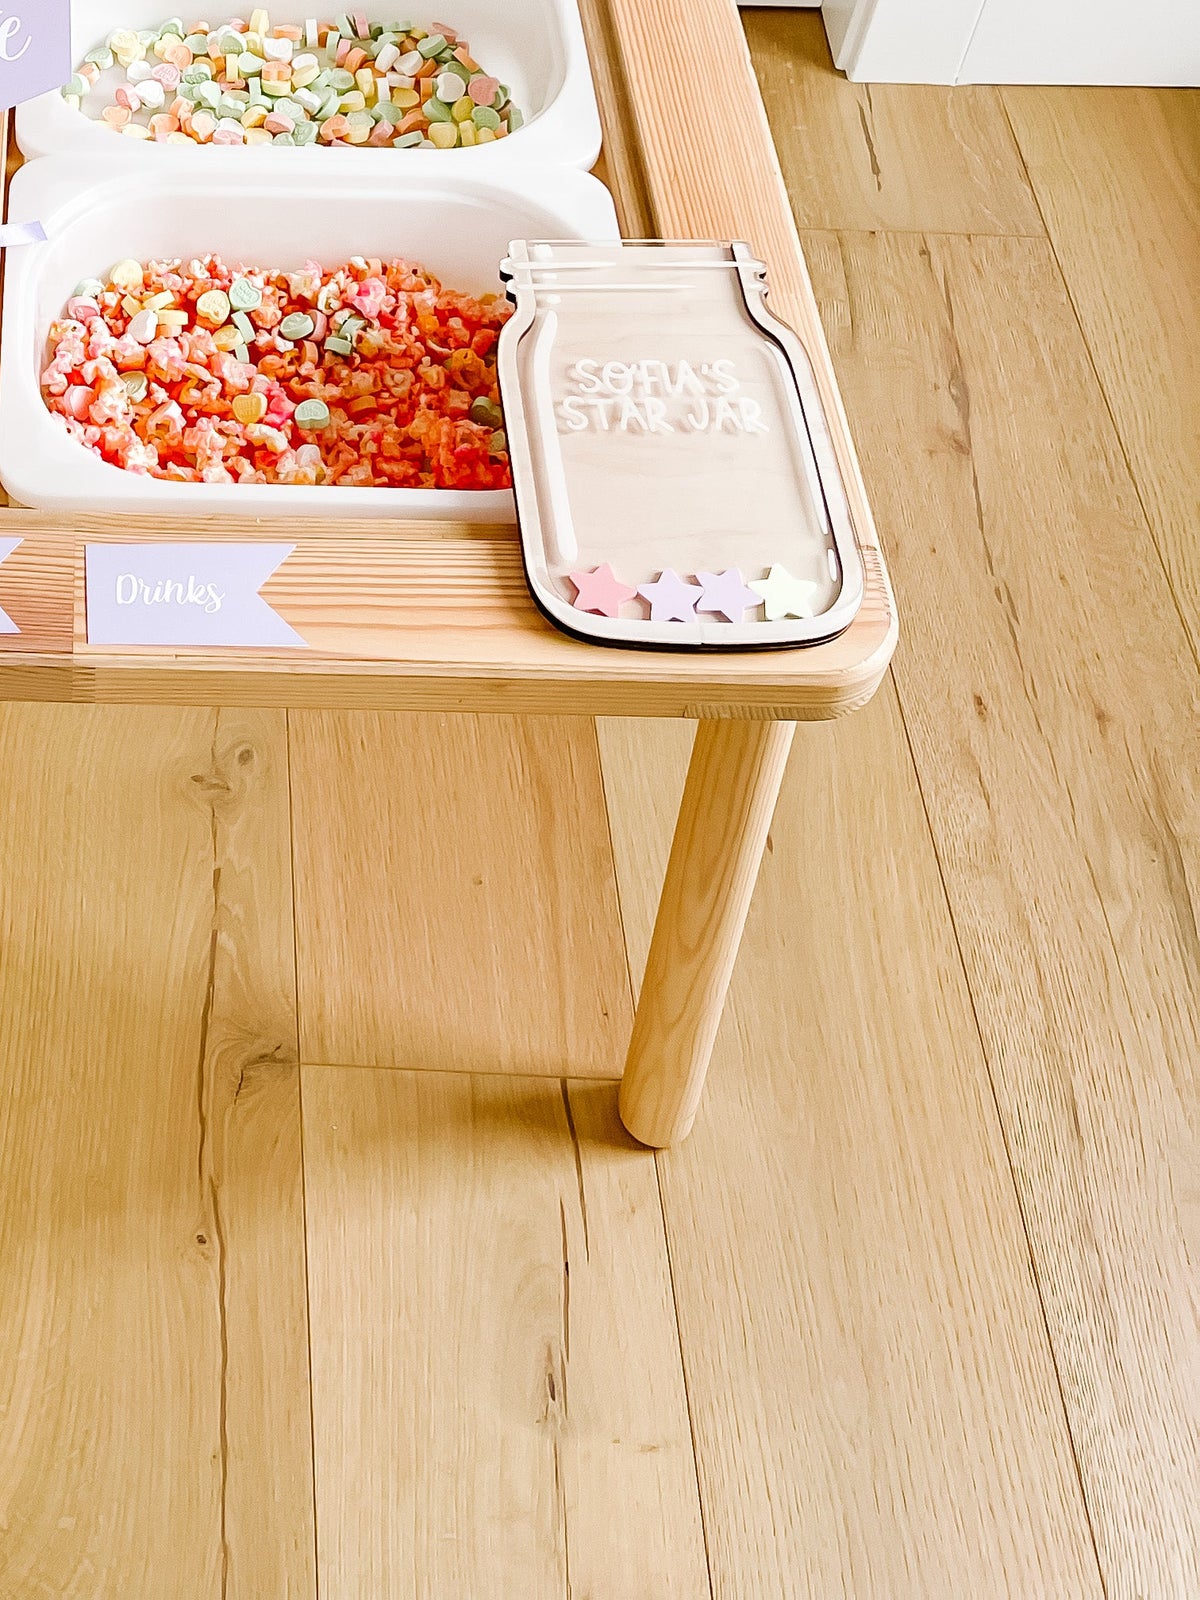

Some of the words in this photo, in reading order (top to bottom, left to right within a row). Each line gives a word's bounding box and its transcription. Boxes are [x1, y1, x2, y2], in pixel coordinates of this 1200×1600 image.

[562, 395, 676, 433] STAR
[687, 396, 770, 433] JAR
[115, 573, 226, 614] Drinks
